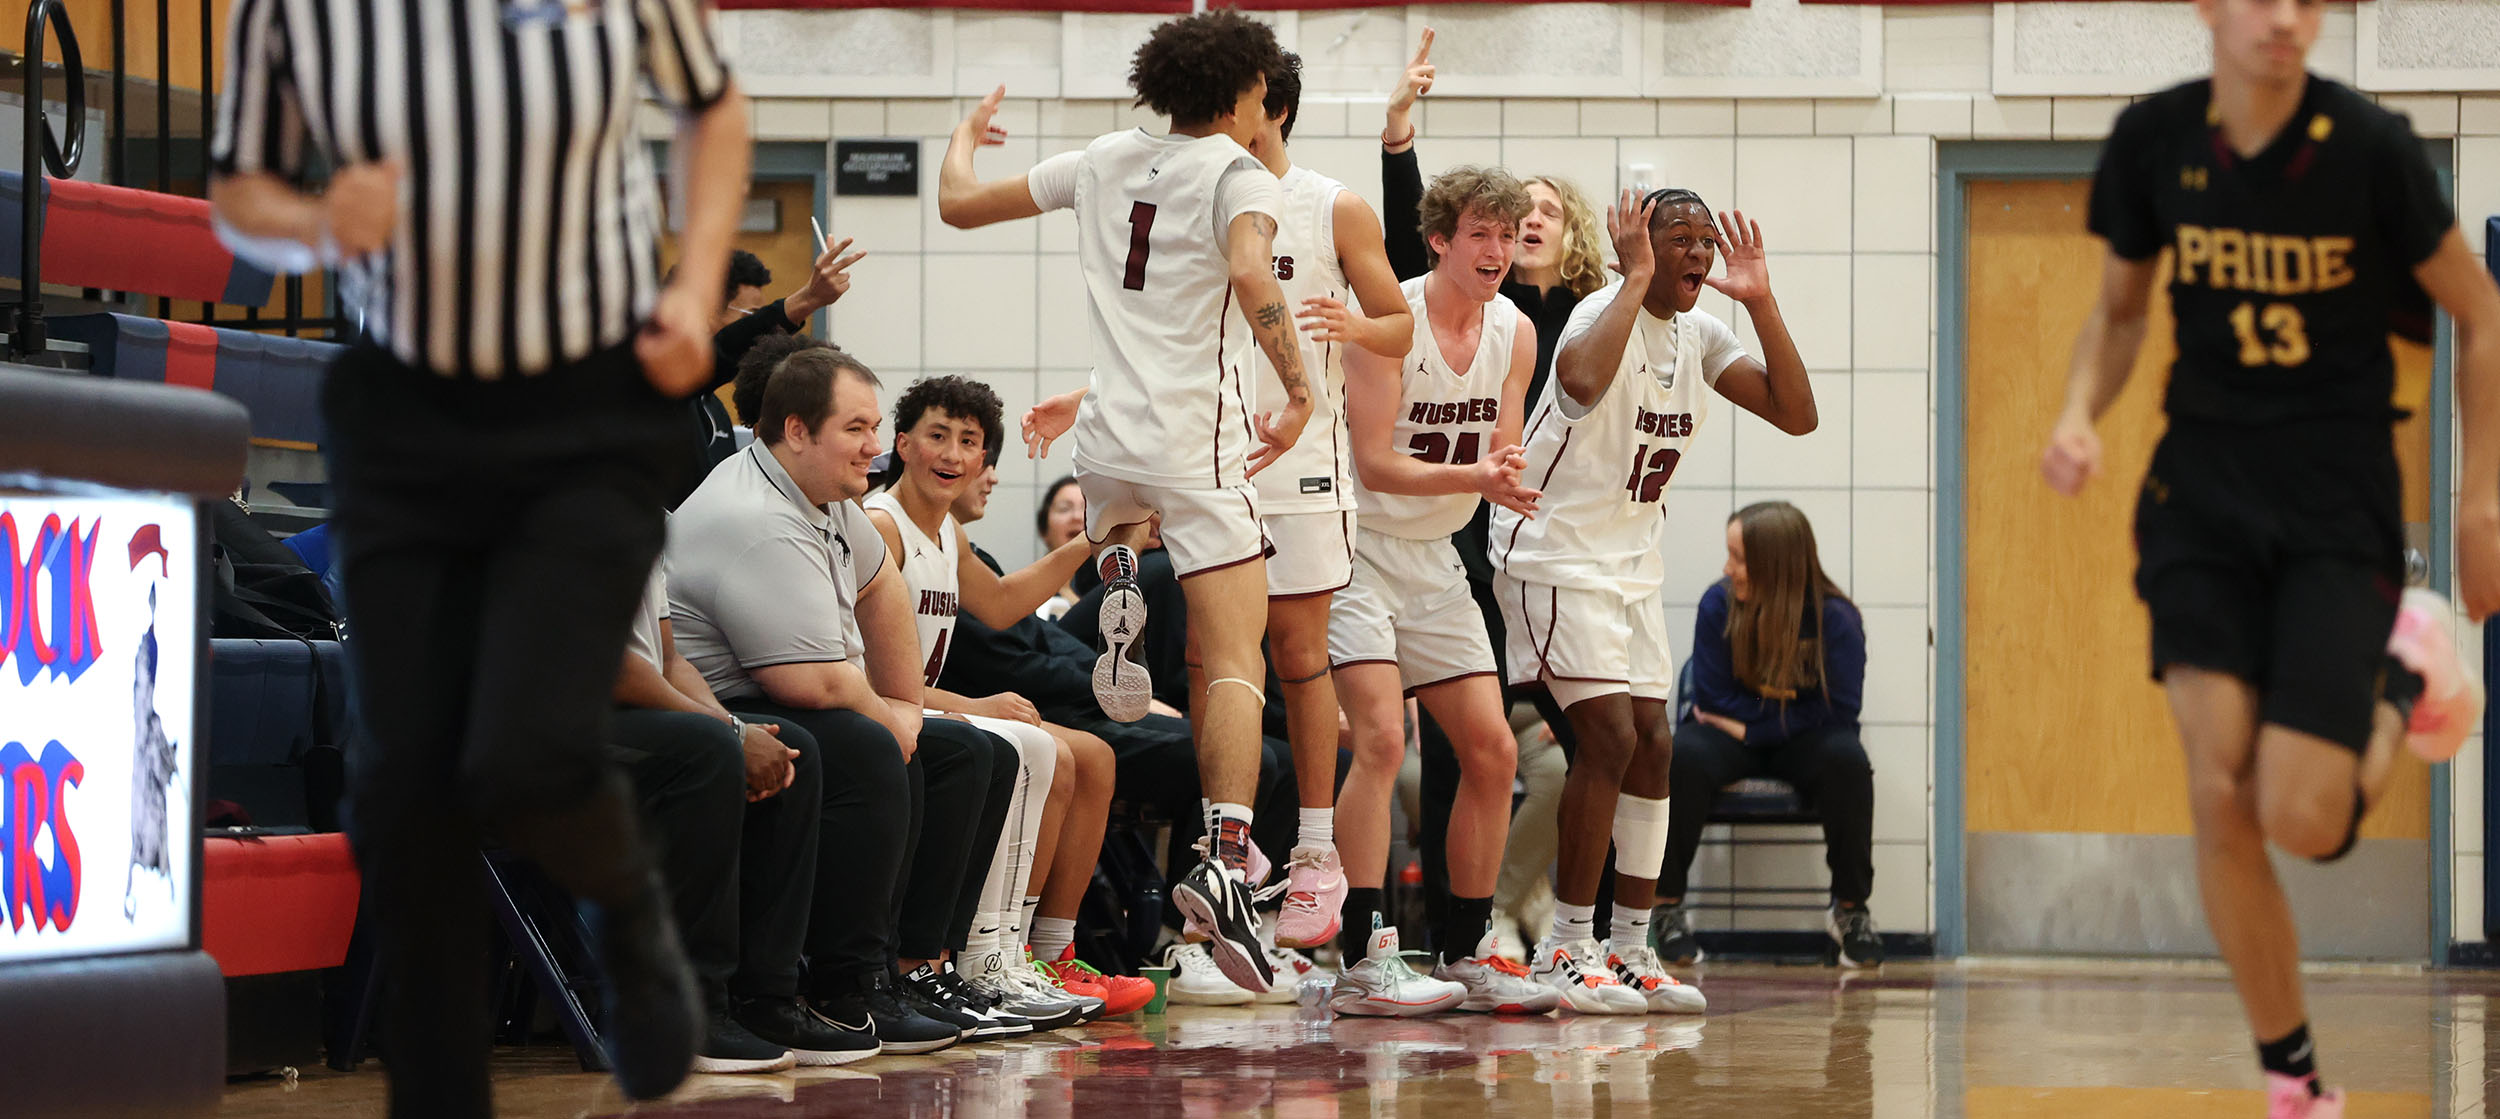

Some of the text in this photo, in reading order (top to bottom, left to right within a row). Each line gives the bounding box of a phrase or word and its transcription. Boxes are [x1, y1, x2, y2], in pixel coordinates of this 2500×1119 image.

[1123, 200, 1157, 291] 1
[2175, 224, 2356, 295] PRIDE
[2228, 302, 2311, 367] 13
[1408, 398, 1498, 425] HUSES
[1635, 405, 1693, 438] HSKES
[0, 739, 84, 934] RS
